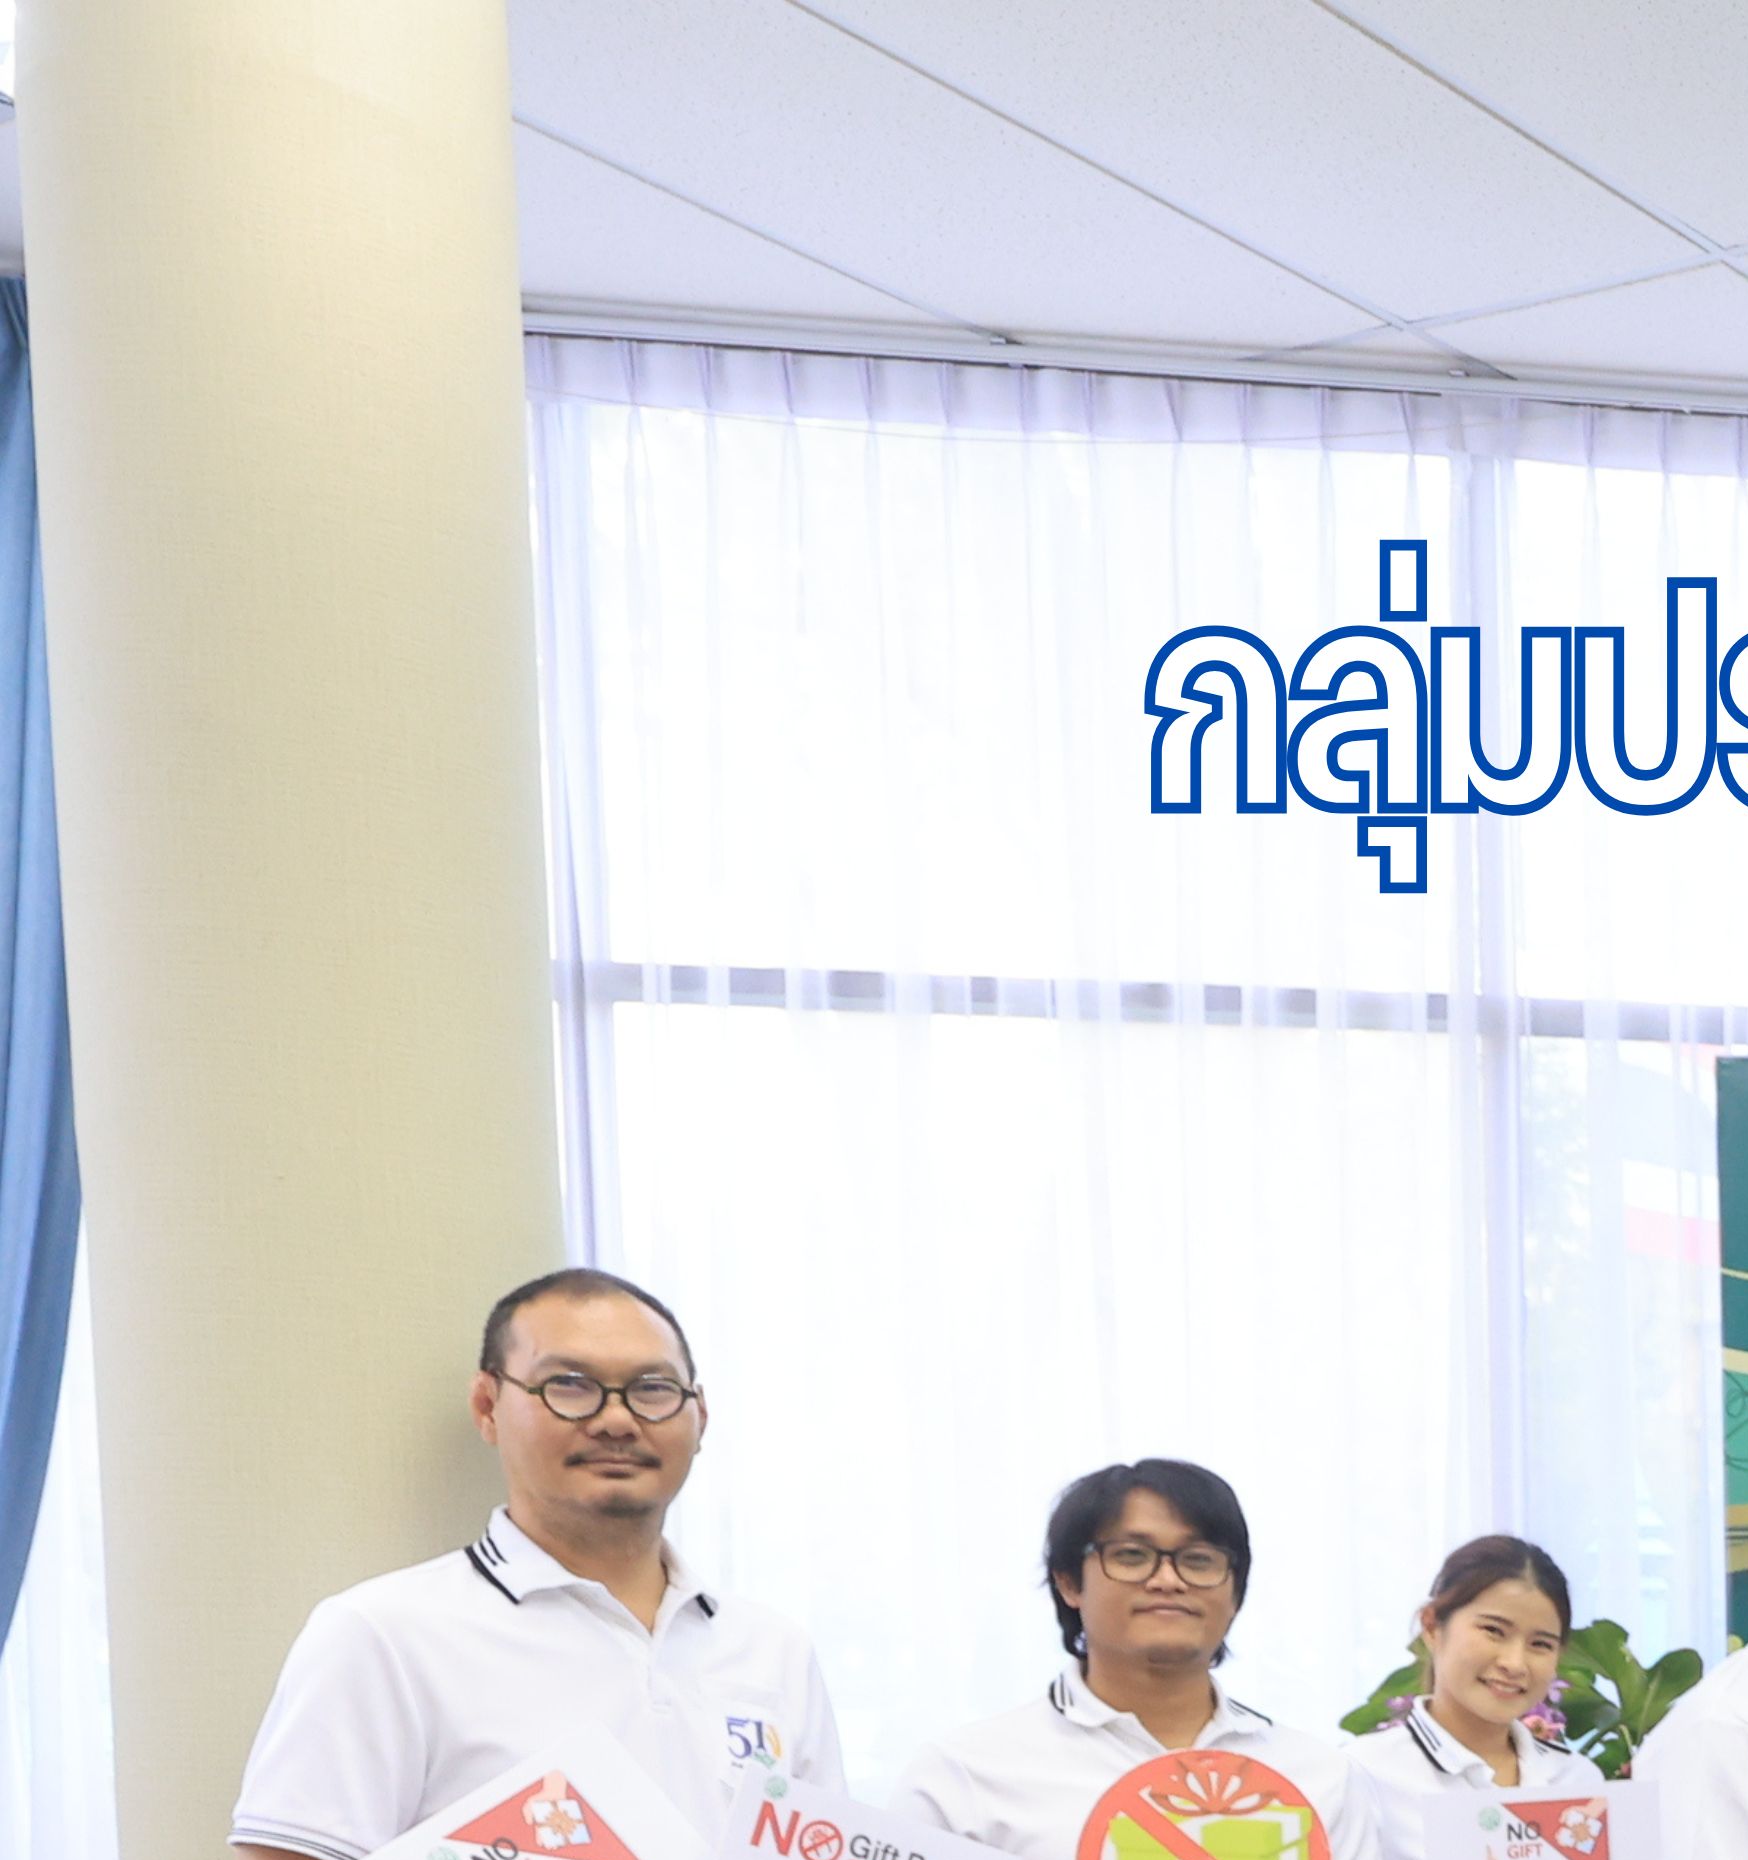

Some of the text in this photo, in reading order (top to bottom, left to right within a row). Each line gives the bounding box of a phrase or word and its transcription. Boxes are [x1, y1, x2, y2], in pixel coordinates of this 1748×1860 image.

[726, 1716, 766, 1759] 51
[1507, 1821, 1541, 1841] NO
[1507, 1843, 1542, 1860] GIFT
